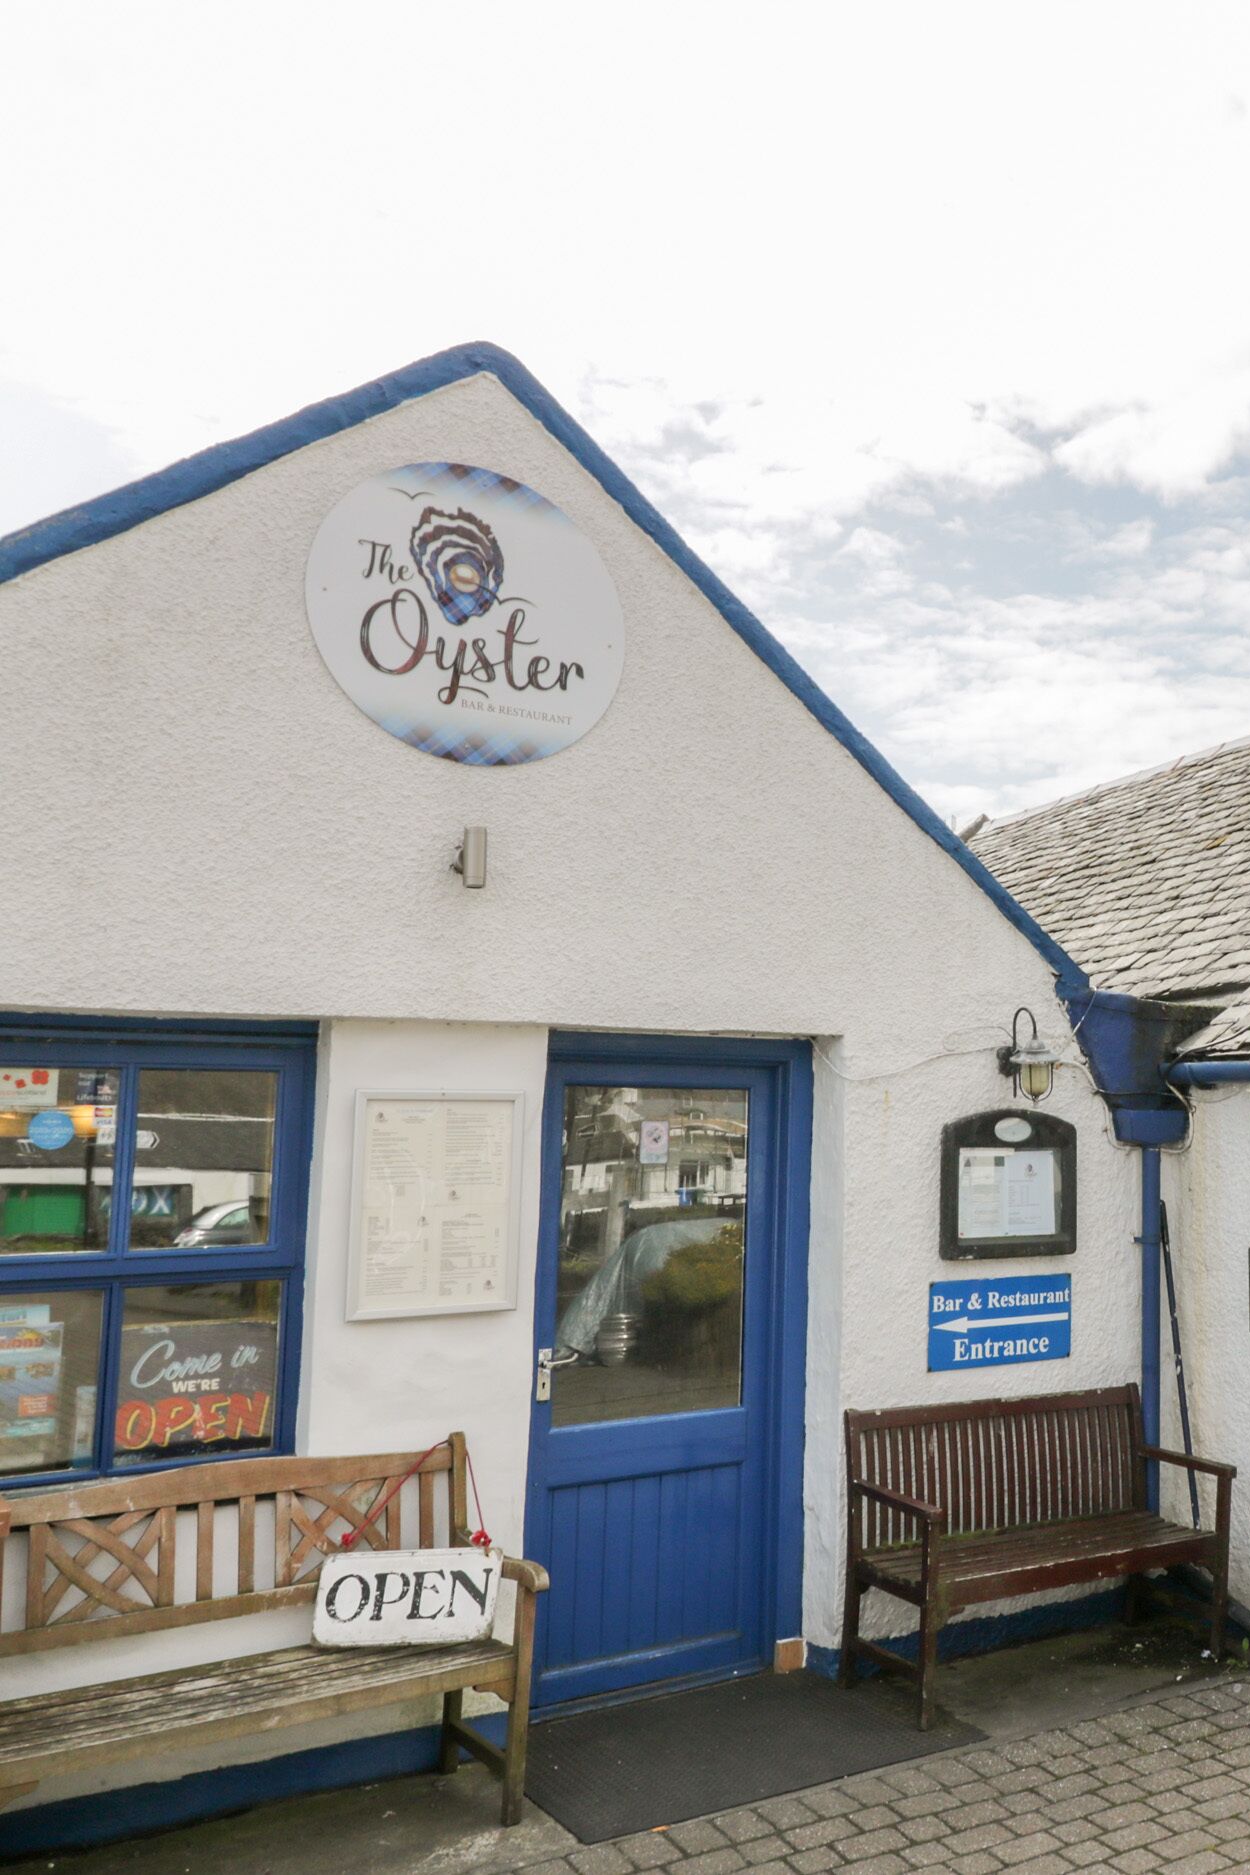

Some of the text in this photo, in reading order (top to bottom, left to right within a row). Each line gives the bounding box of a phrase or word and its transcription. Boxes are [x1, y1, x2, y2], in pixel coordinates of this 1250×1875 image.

[358, 538, 413, 584] The
[359, 588, 585, 705] Oyster
[461, 699, 573, 725] BAR & RESTAURANT
[932, 1287, 1070, 1313] Bar & Restaurant
[130, 1340, 260, 1388] Come in
[952, 1336, 1050, 1362] Entrance
[172, 1378, 221, 1393] WE'RE
[115, 1391, 270, 1449] OPEN
[325, 1568, 494, 1624] OPEN
